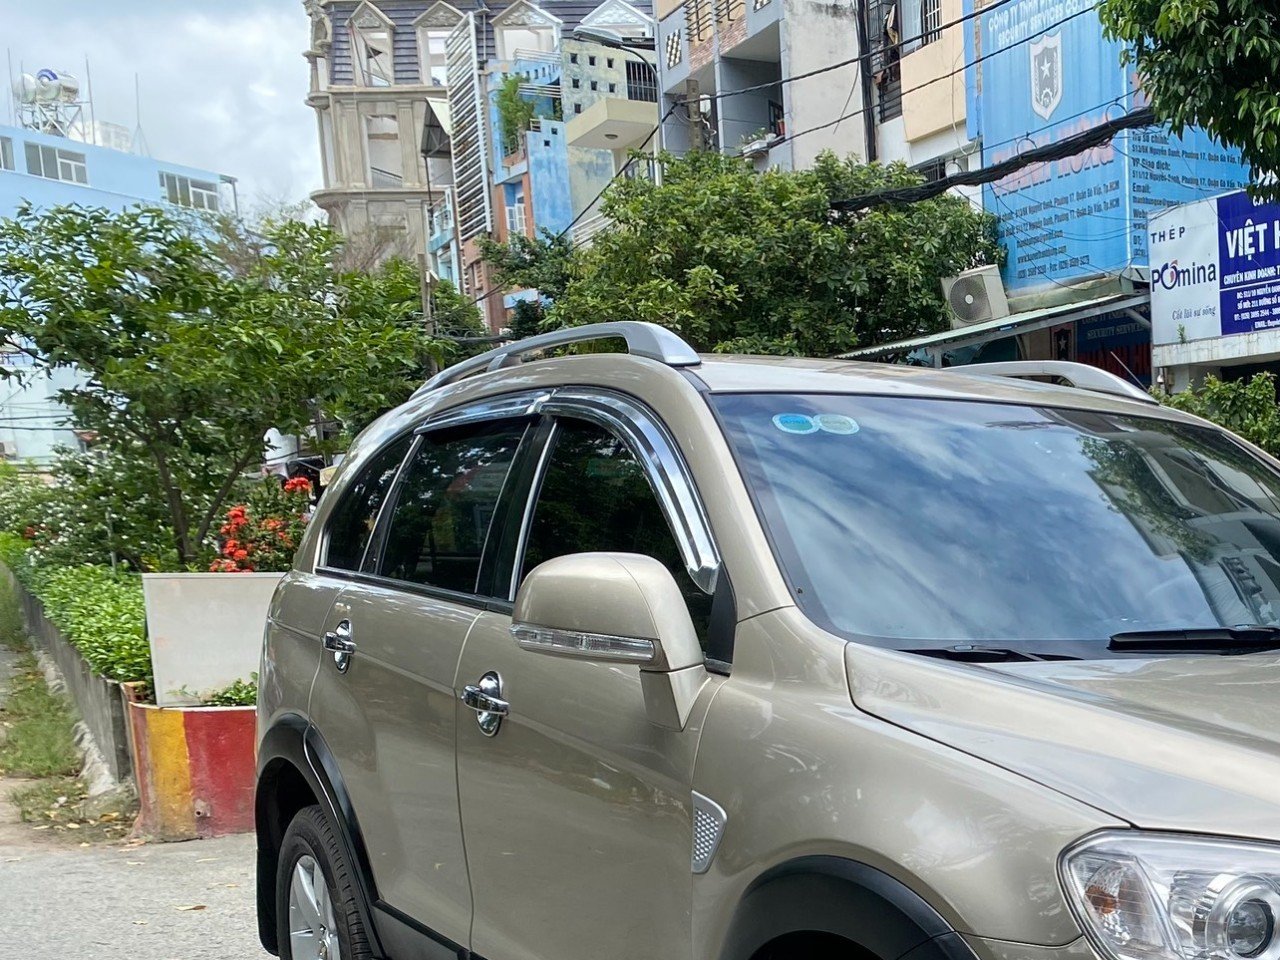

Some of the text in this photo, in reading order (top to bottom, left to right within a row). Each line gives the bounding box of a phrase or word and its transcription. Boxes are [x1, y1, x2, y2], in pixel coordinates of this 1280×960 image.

[999, 20, 1028, 47] SECURITY
[1030, 3, 1063, 32] SERVICES
[1133, 183, 1151, 193] Email:
[1133, 209, 1147, 218] Web
[1151, 225, 1185, 243] THÉP
[1226, 218, 1267, 260] VIỆT
